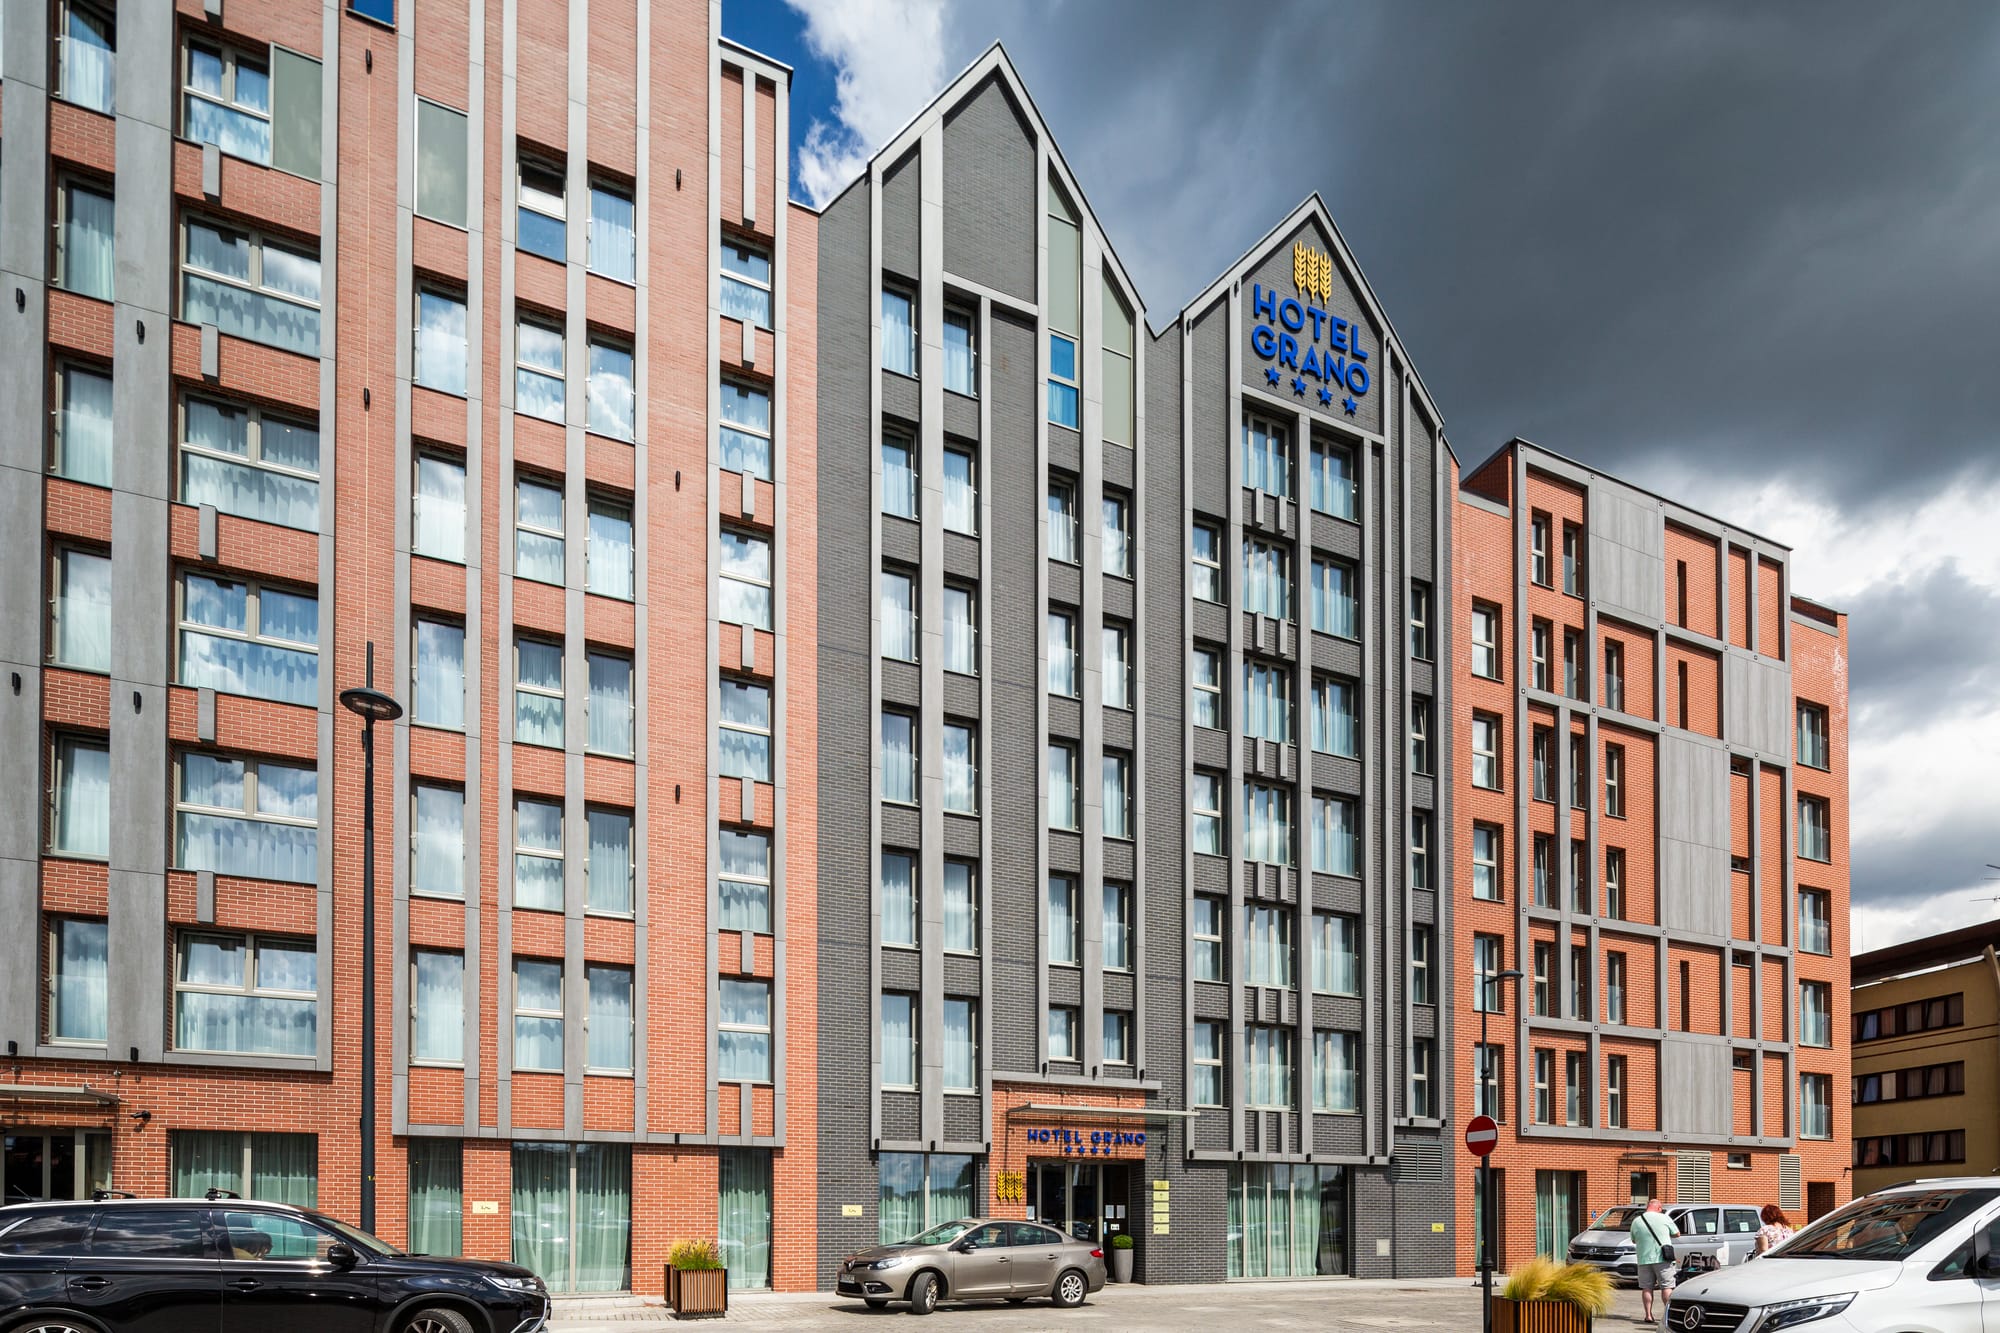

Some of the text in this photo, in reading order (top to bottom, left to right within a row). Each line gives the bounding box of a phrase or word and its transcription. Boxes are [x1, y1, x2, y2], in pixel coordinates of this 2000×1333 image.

[1254, 283, 1369, 359] HOTEL
[1252, 324, 1370, 393] GRANO
[1027, 1129, 1147, 1145] HOTEL GRANO
